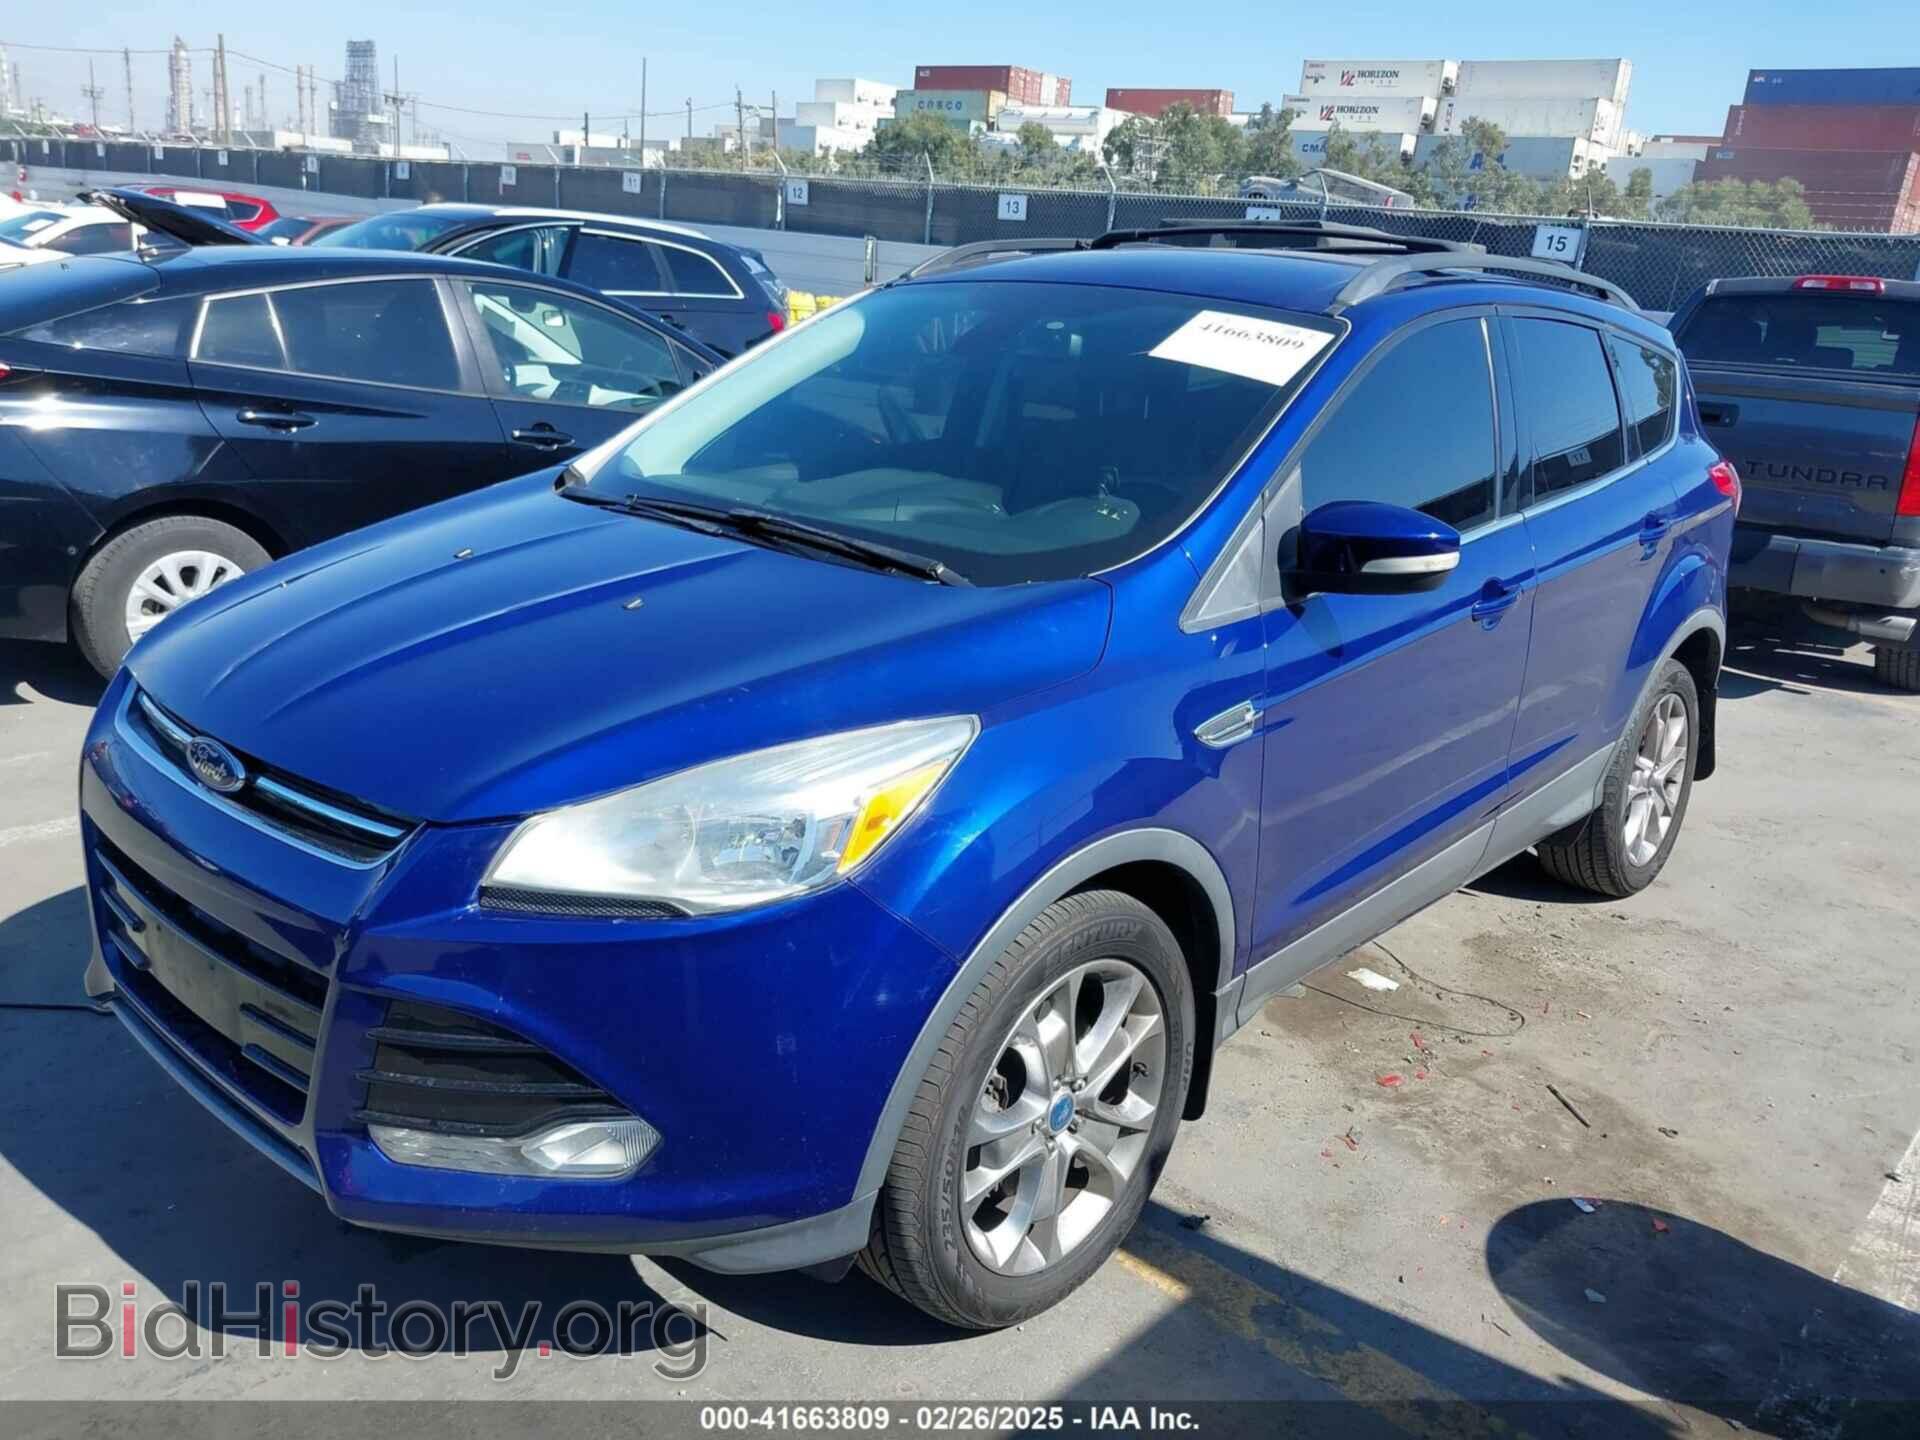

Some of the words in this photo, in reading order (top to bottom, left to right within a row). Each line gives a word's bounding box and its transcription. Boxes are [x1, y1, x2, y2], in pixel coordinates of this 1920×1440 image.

[1357, 69, 1400, 79] HORIZON
[1336, 105, 1379, 114] HORIZON
[792, 187, 803, 200] 12
[1004, 200, 1020, 215] 13
[1546, 234, 1568, 252] 15
[1745, 460, 1888, 490] TUNDRA
[191, 743, 228, 781] Ford
